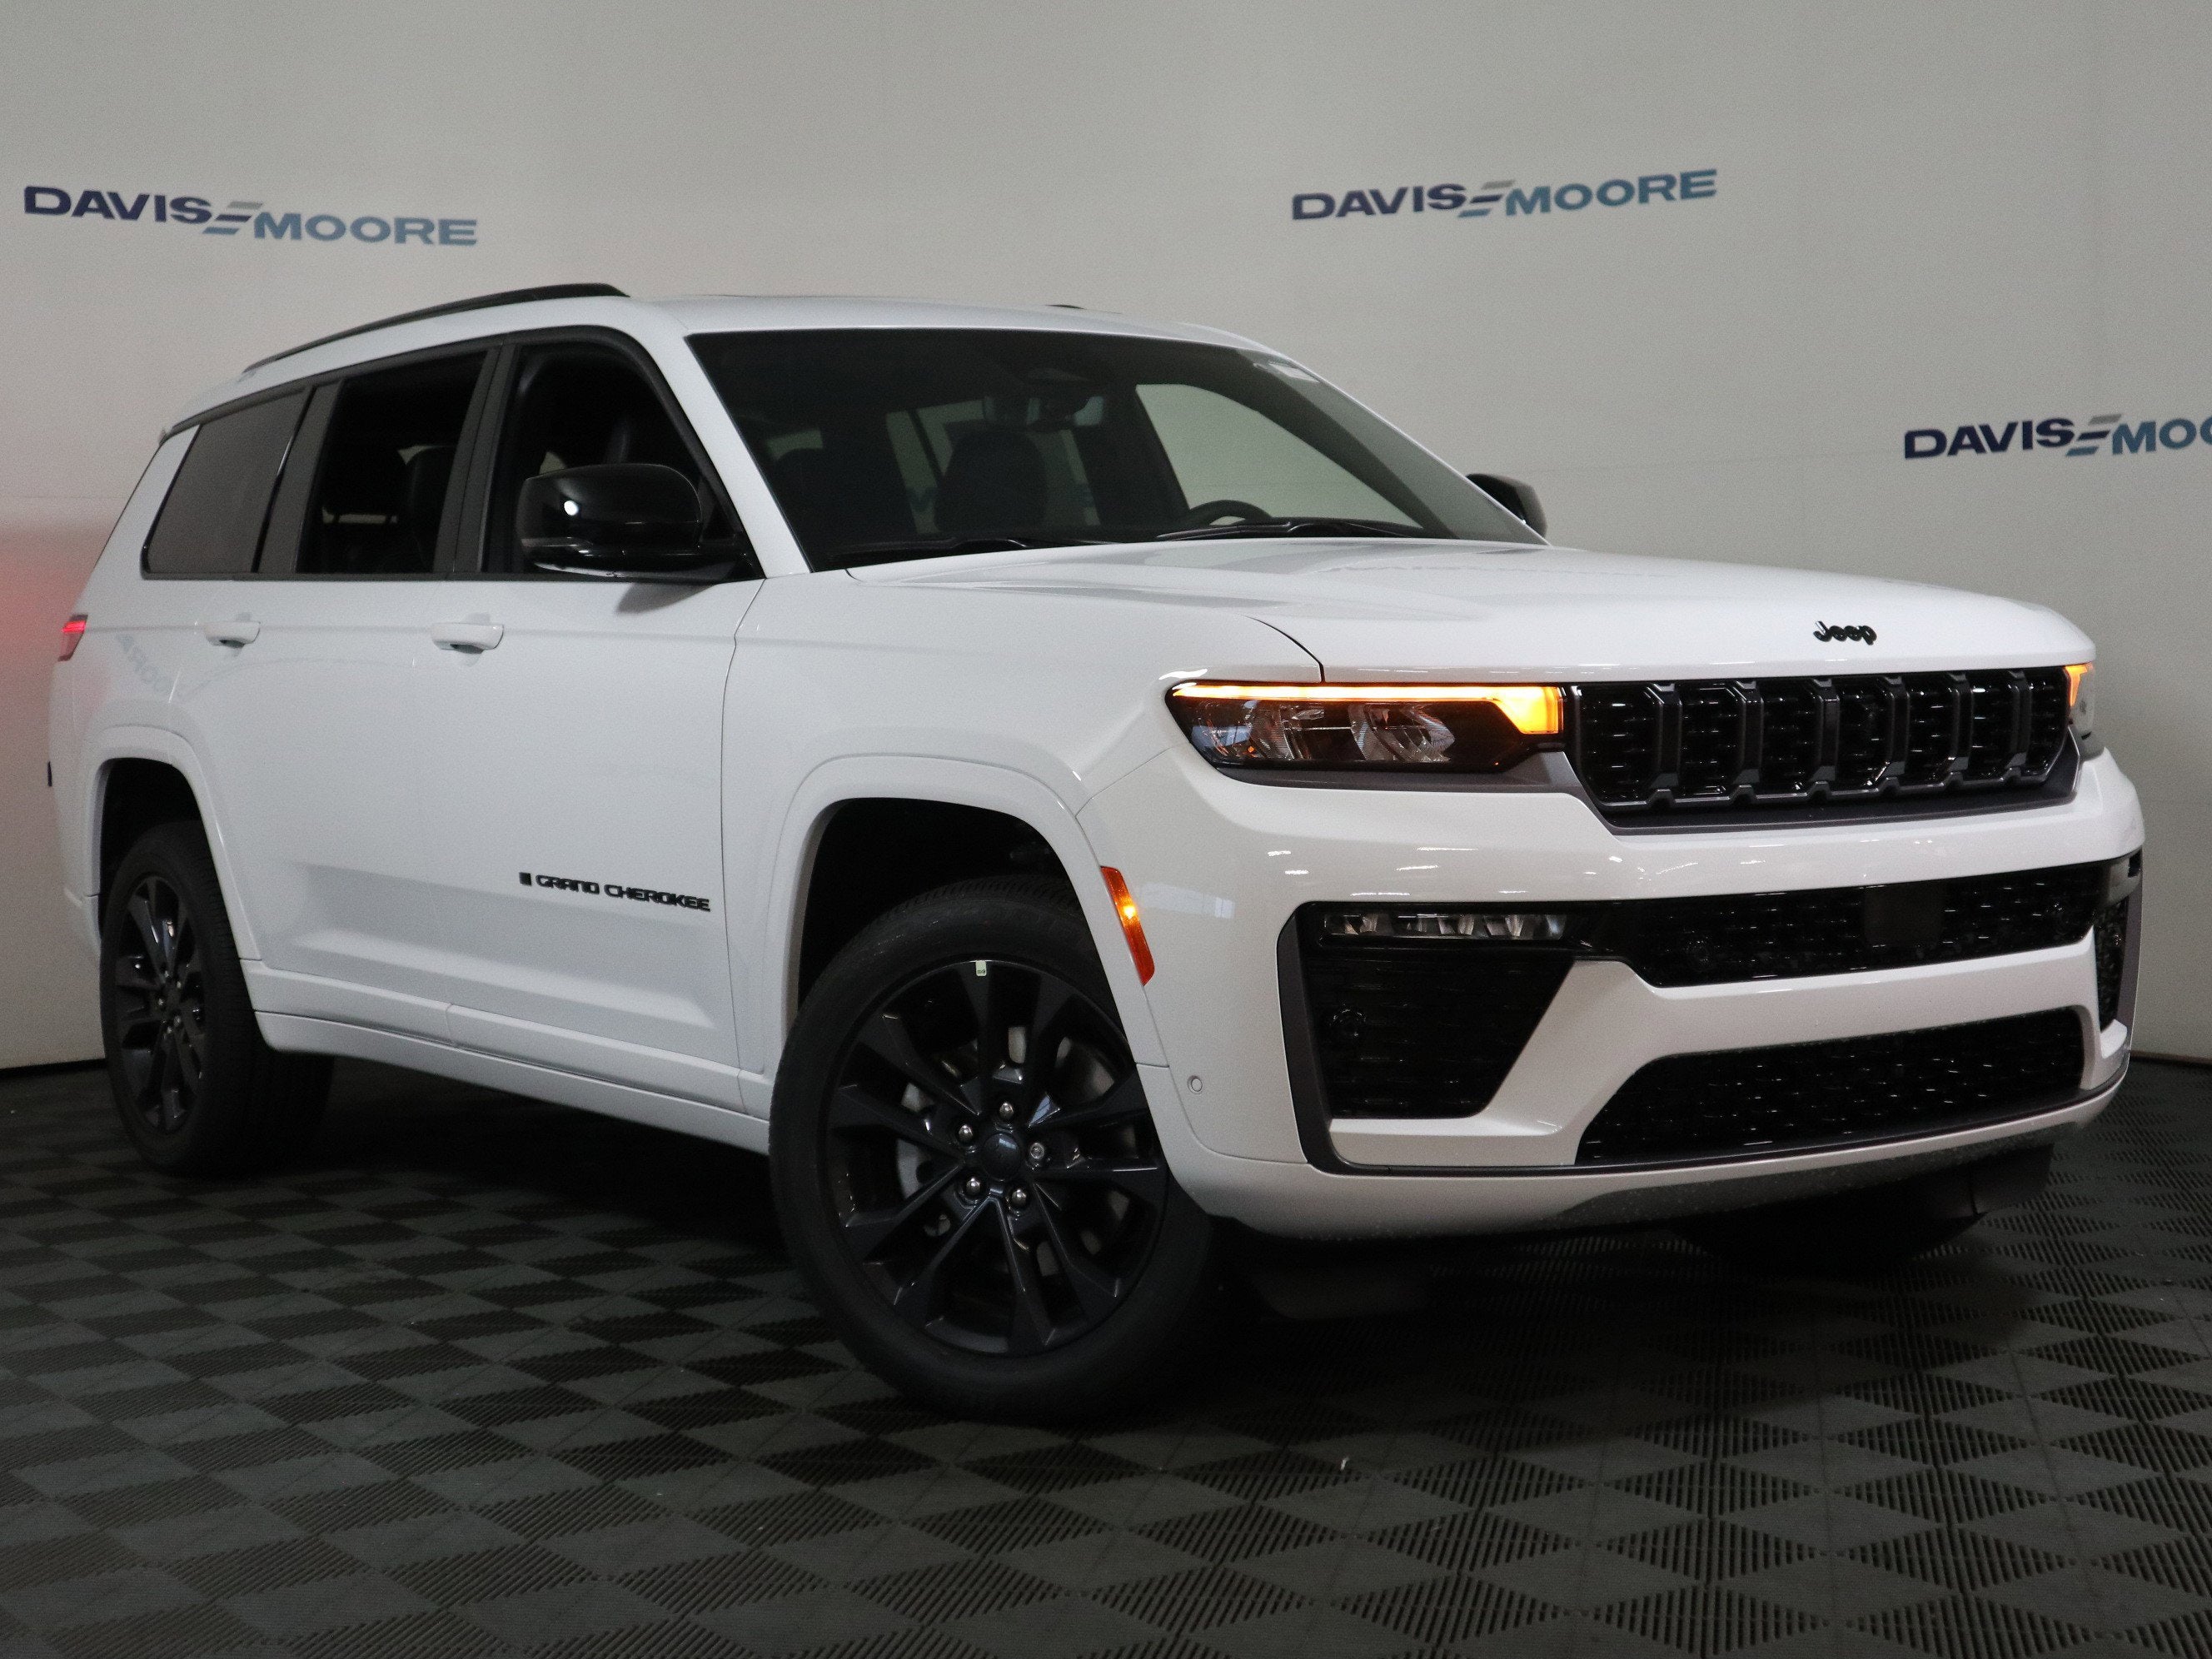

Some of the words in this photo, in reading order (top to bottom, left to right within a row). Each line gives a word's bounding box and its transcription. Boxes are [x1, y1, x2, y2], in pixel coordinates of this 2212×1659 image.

[1292, 182, 1467, 221] DAVIS
[1505, 169, 1718, 217] MOORE
[23, 186, 212, 225] DAVIS
[253, 211, 478, 247] MOORE
[1904, 417, 2075, 459] DAVIS
[1813, 620, 1877, 645] Jeep
[536, 874, 600, 894] GRAND
[604, 884, 710, 913] CHEROKEE
